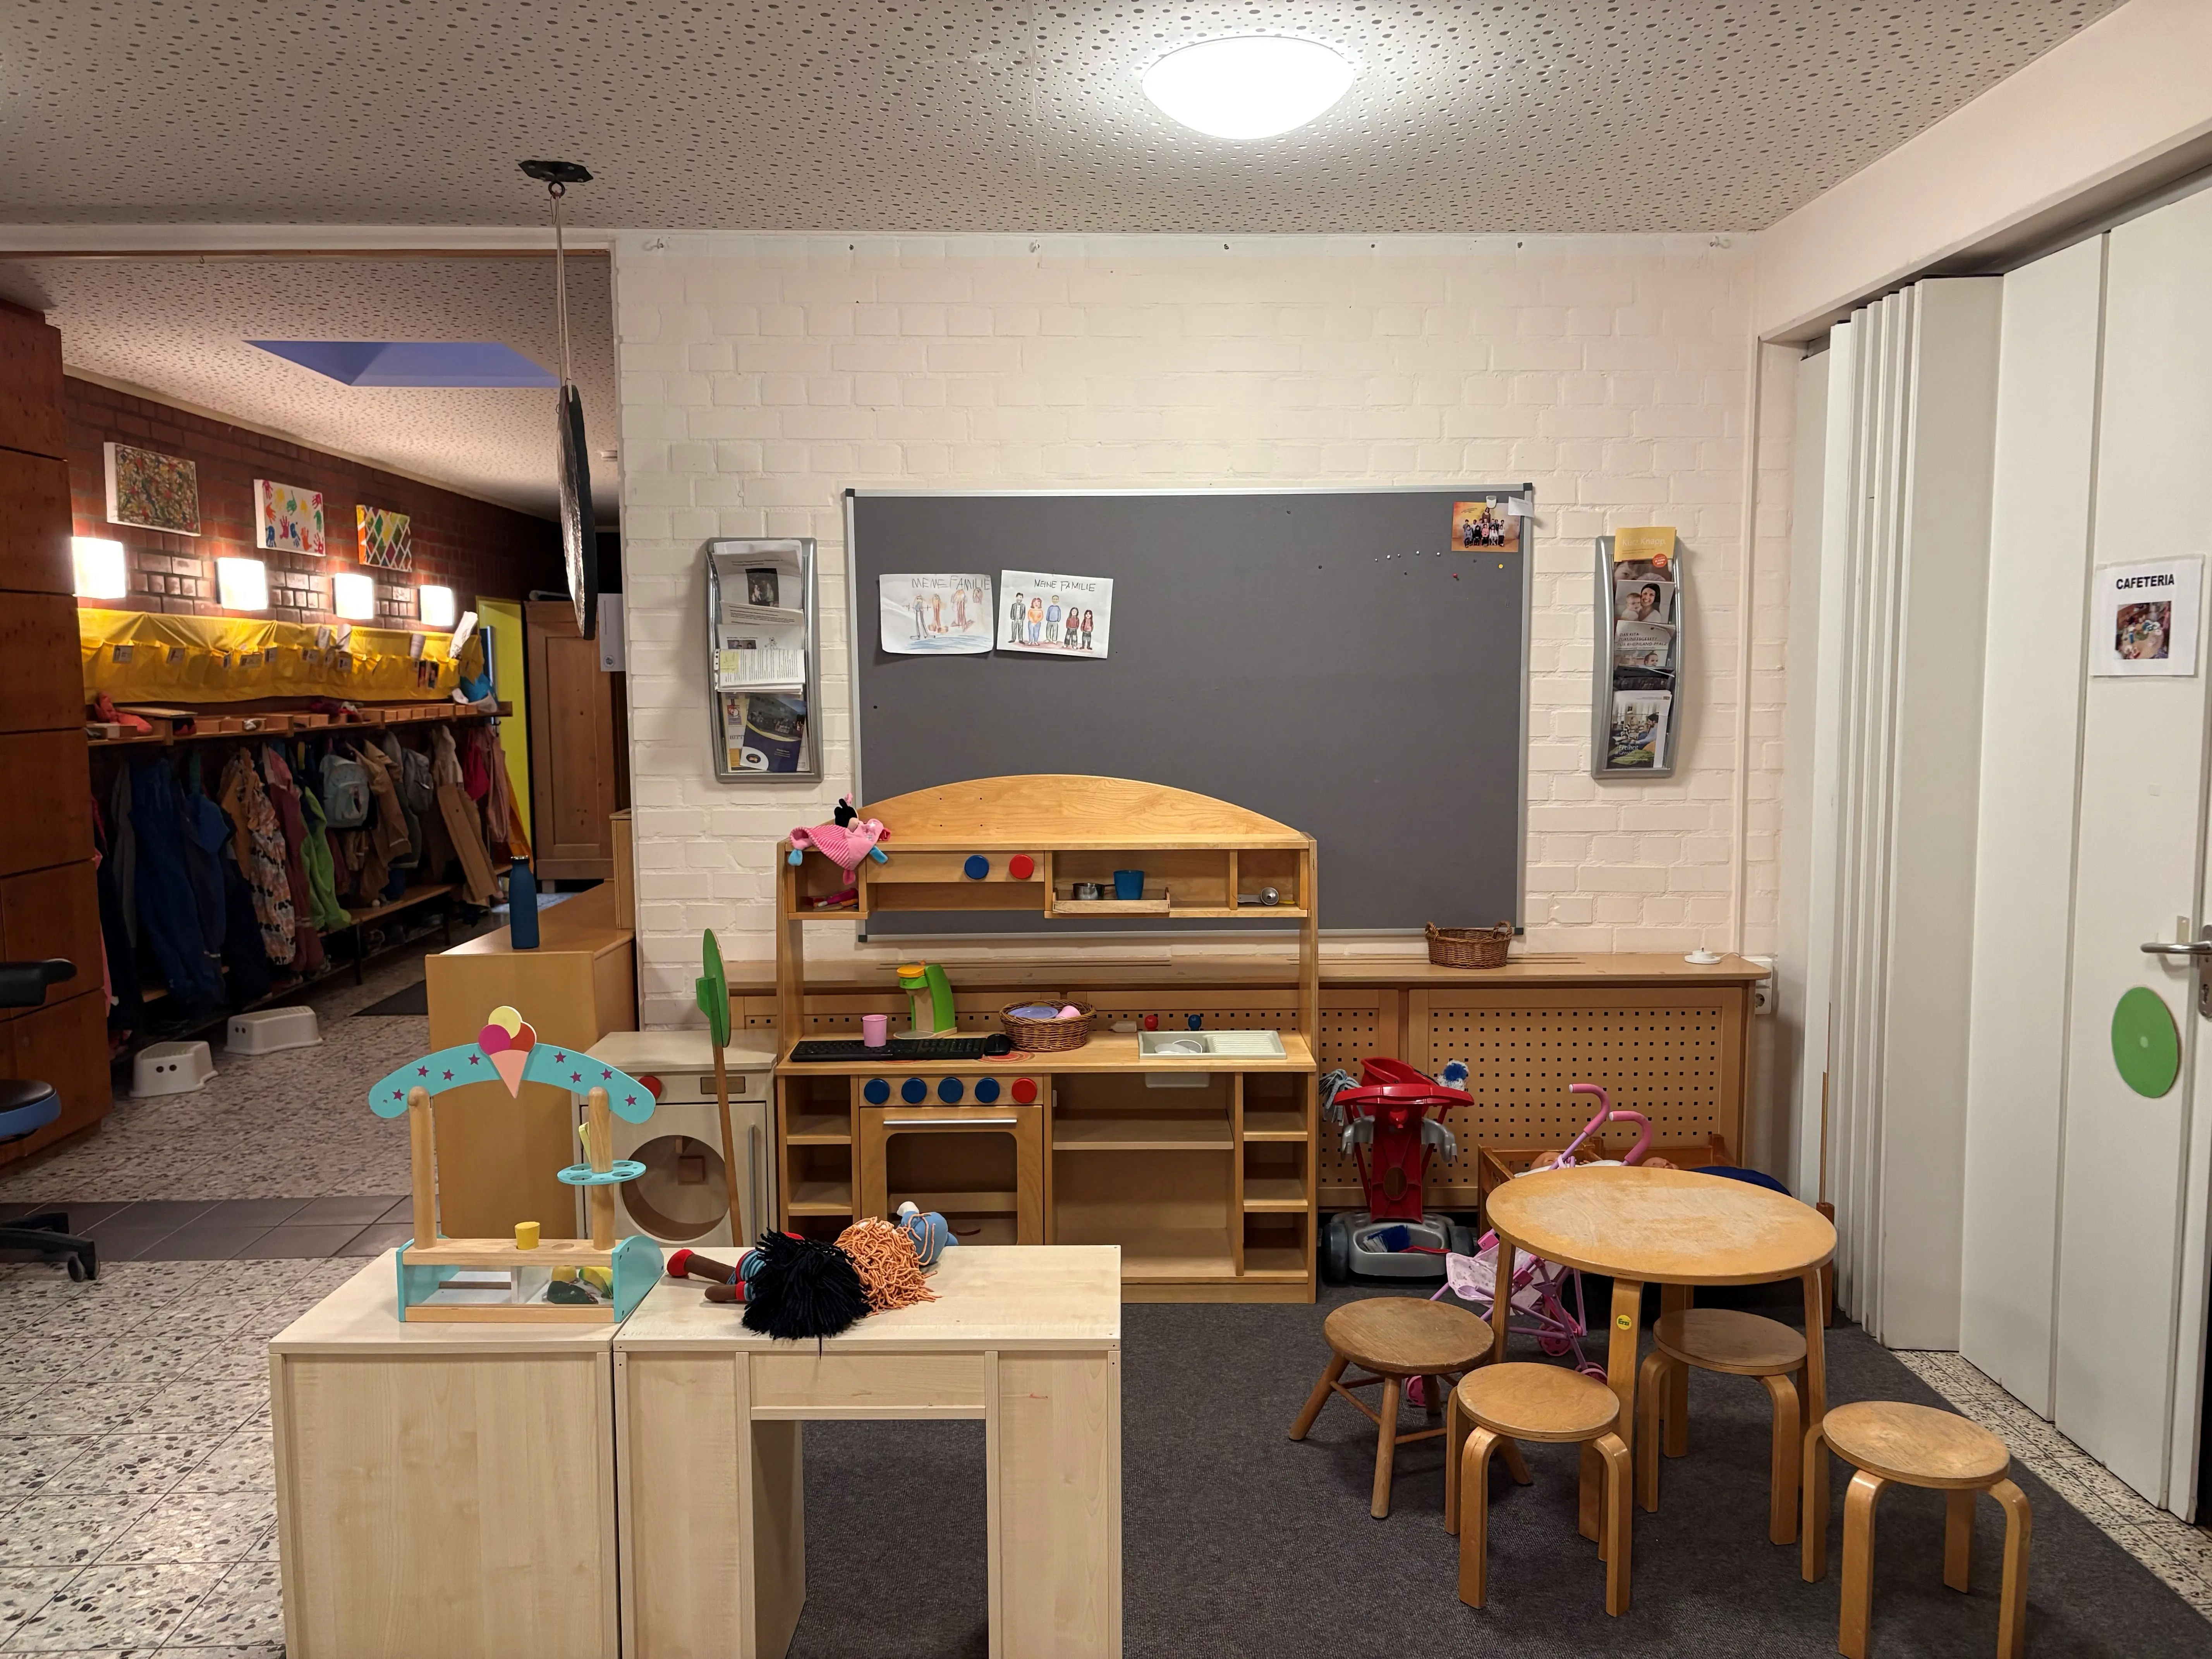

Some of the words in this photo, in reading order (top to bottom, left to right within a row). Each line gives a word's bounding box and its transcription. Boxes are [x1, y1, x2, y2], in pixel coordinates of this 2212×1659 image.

[950, 575, 991, 591] FAMILIE
[1034, 579, 1057, 588] MEINE
[1060, 581, 1096, 591] FAMILIE
[2116, 574, 2175, 589] CAFETERIA
